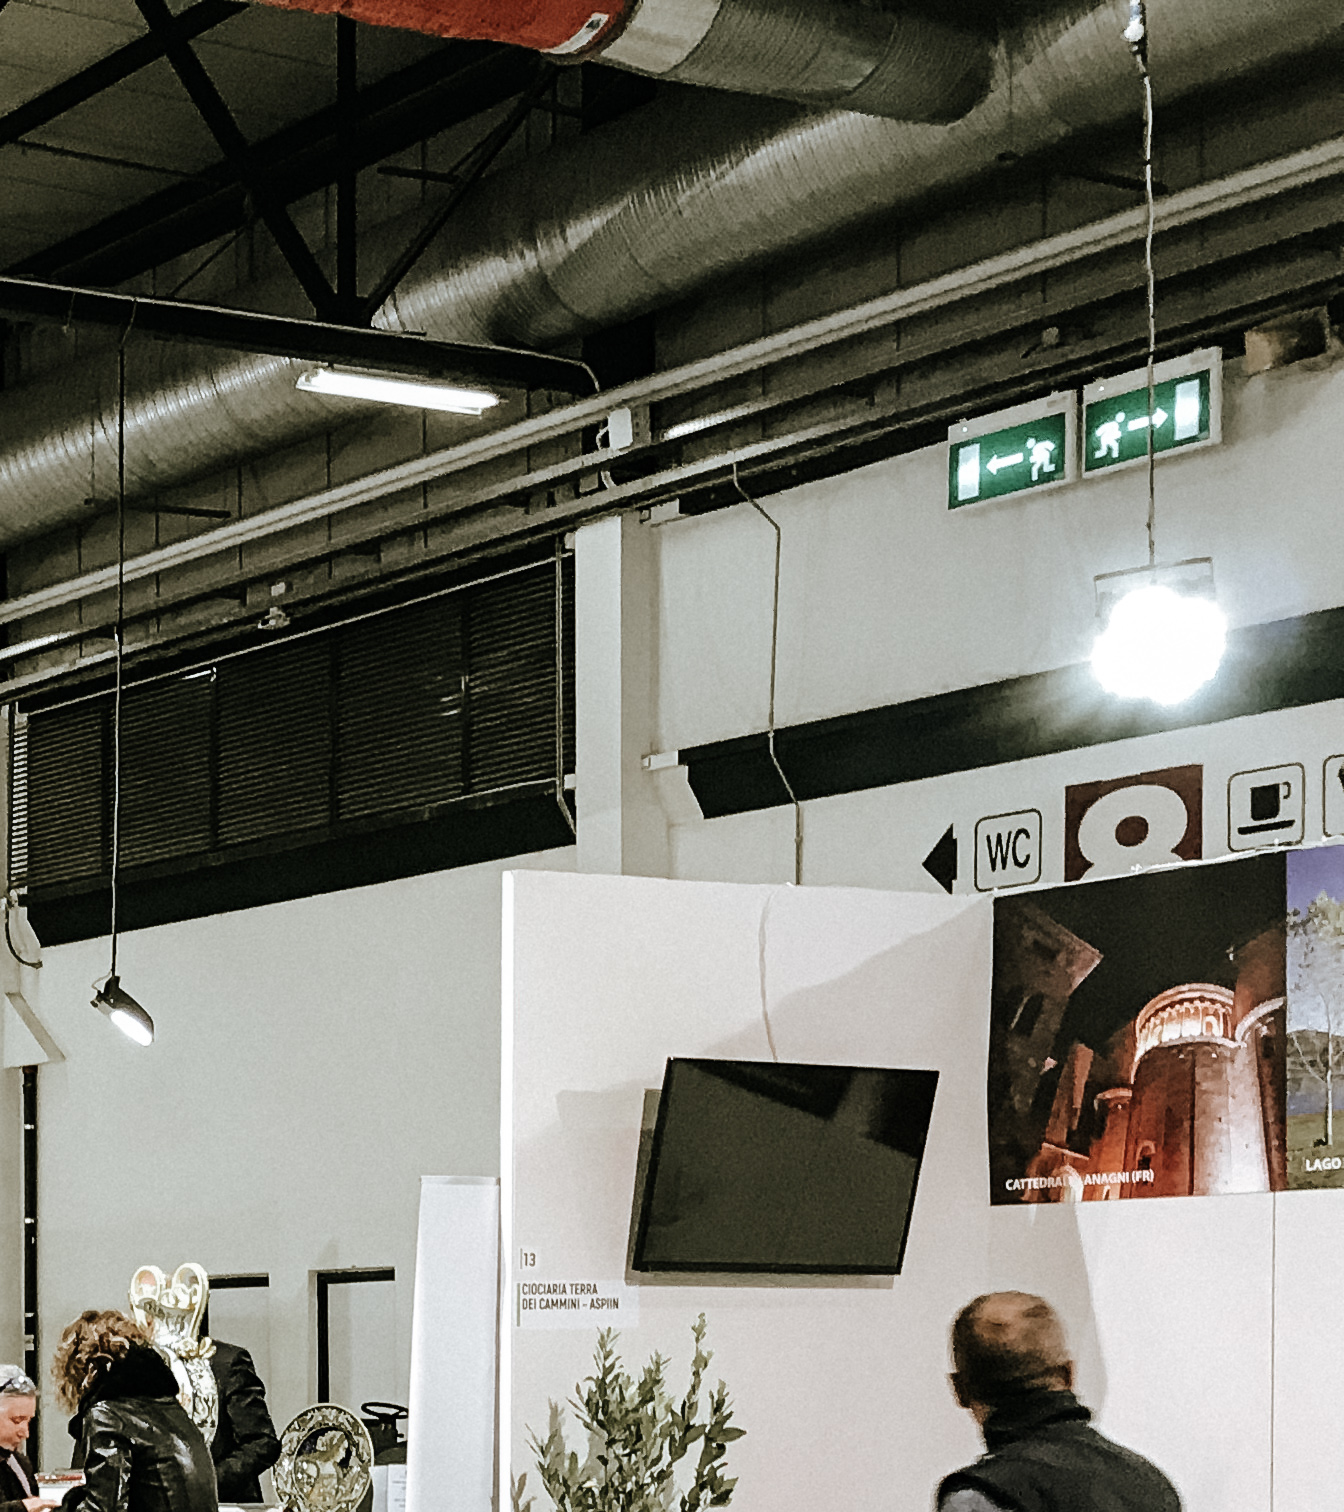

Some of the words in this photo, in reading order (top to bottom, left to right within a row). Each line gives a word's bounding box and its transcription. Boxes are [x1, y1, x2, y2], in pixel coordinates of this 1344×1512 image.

[986, 828, 1031, 872] WC
[1305, 1157, 1342, 1172] LAGO
[1005, 1176, 1066, 1191] CATTEDRA
[1084, 1172, 1130, 1186] ANAGNI
[1131, 1168, 1155, 1183] (FR)
[523, 1252, 537, 1267] 13
[521, 1283, 567, 1295] CIOCIARIA
[569, 1283, 599, 1295] TERRA
[522, 1298, 537, 1310] DEI
[539, 1298, 580, 1310] CAMMINI
[589, 1298, 620, 1310] ASPIIN
